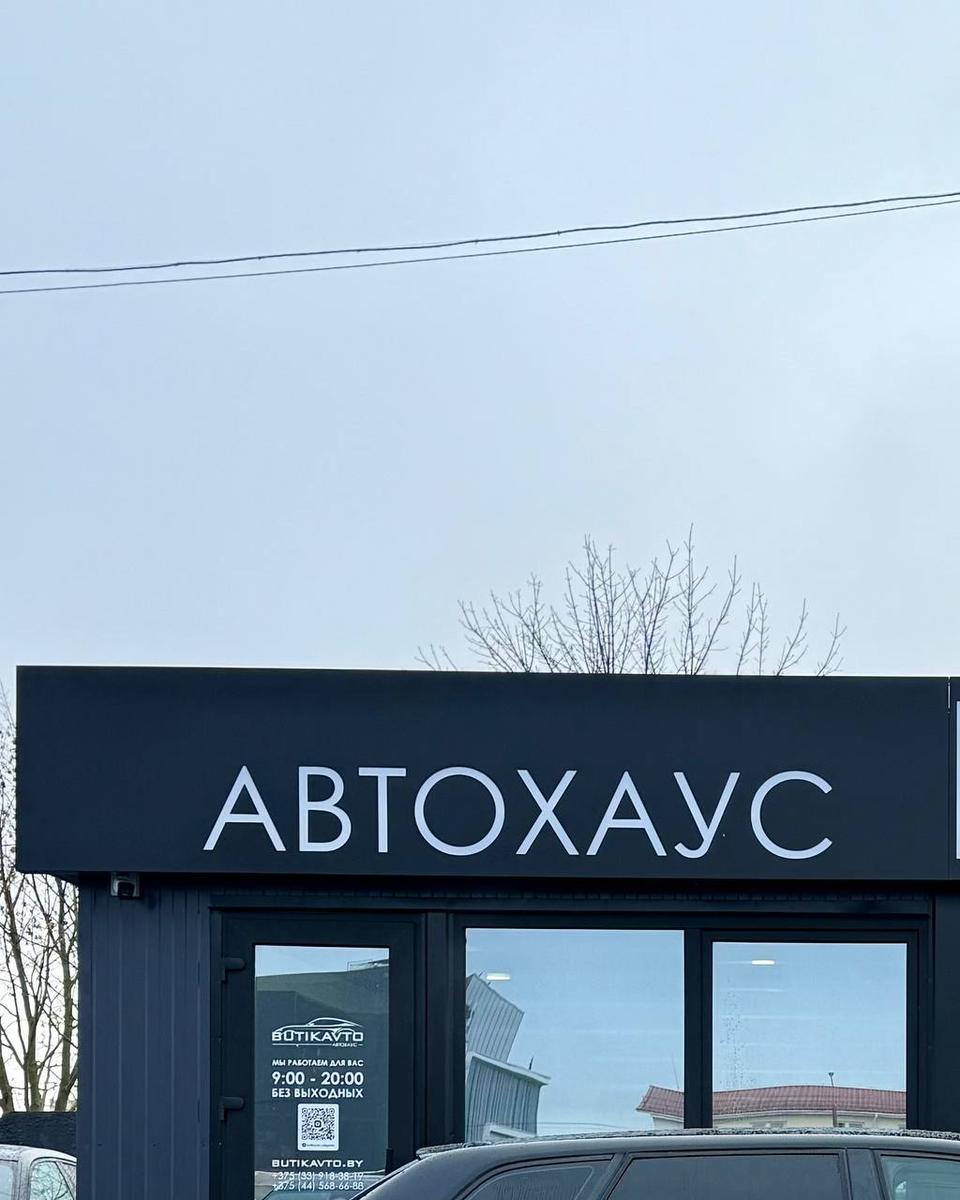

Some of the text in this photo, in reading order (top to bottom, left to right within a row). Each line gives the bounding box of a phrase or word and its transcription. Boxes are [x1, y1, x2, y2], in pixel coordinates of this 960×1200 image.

[203, 765, 834, 860] АВТОХАУС
[271, 1031, 364, 1042] BUTIKAVTO
[272, 1059, 364, 1067] МЫ РАБОТАЕМ ДЛЯ ВАС
[272, 1071, 305, 1085] 9:00
[321, 1071, 364, 1085] 20:00
[272, 1088, 364, 1099] БЕЗ ВЫХОДНЫХ
[271, 1159, 364, 1168] BUTIKAVTO.BY
[298, 1181, 315, 1192] (44)
[318, 1181, 365, 1191] 568-66-88
